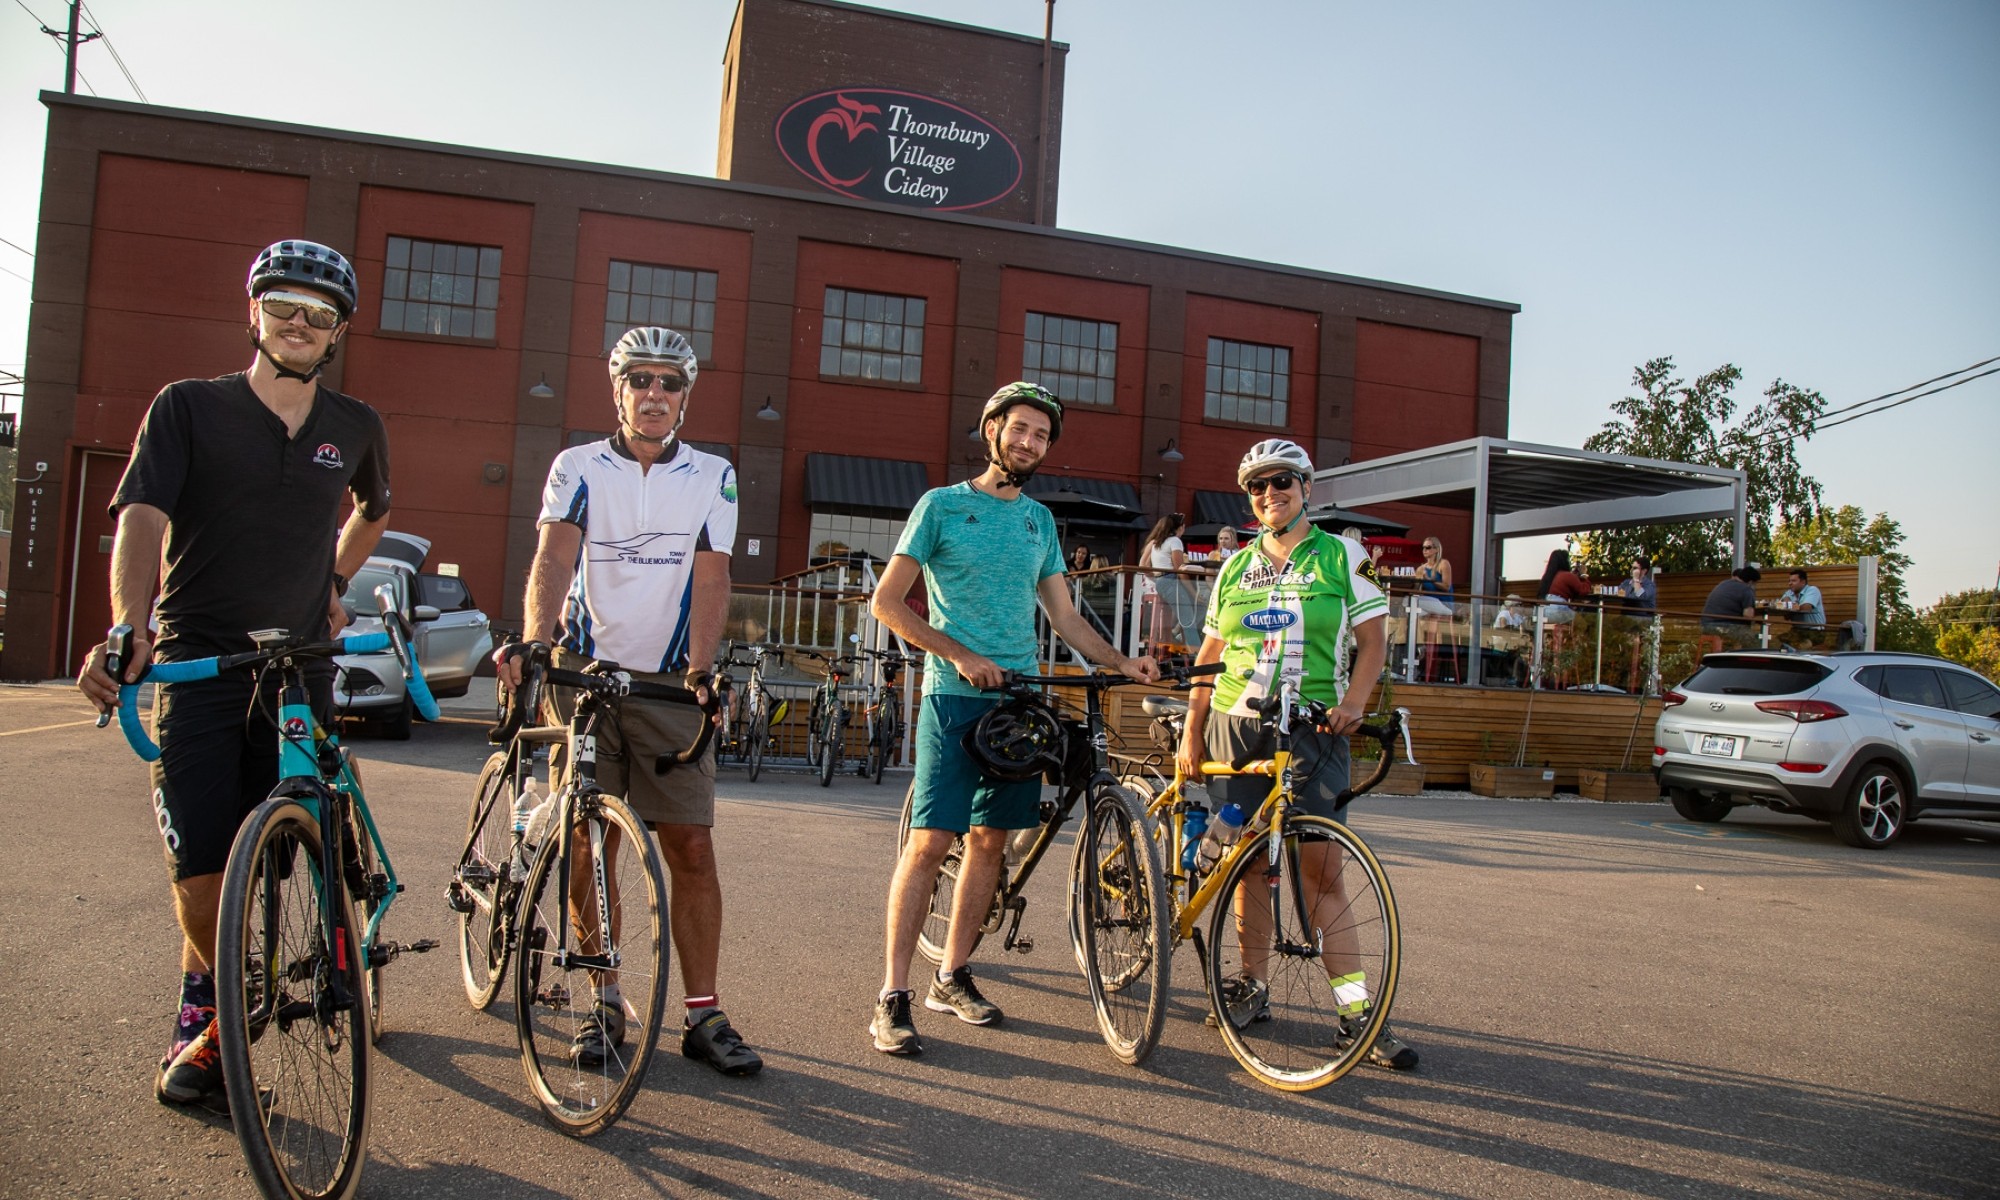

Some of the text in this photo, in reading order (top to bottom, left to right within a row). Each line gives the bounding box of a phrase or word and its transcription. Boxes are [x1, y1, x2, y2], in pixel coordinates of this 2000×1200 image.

[888, 104, 990, 150] Thornbury
[887, 134, 956, 174] Village
[883, 166, 949, 204] Cidery
[28, 487, 43, 495] 90
[28, 539, 34, 553] ST
[1249, 614, 1291, 626] MATTAMY
[153, 787, 180, 855] POC
[595, 856, 607, 923] ARGON
